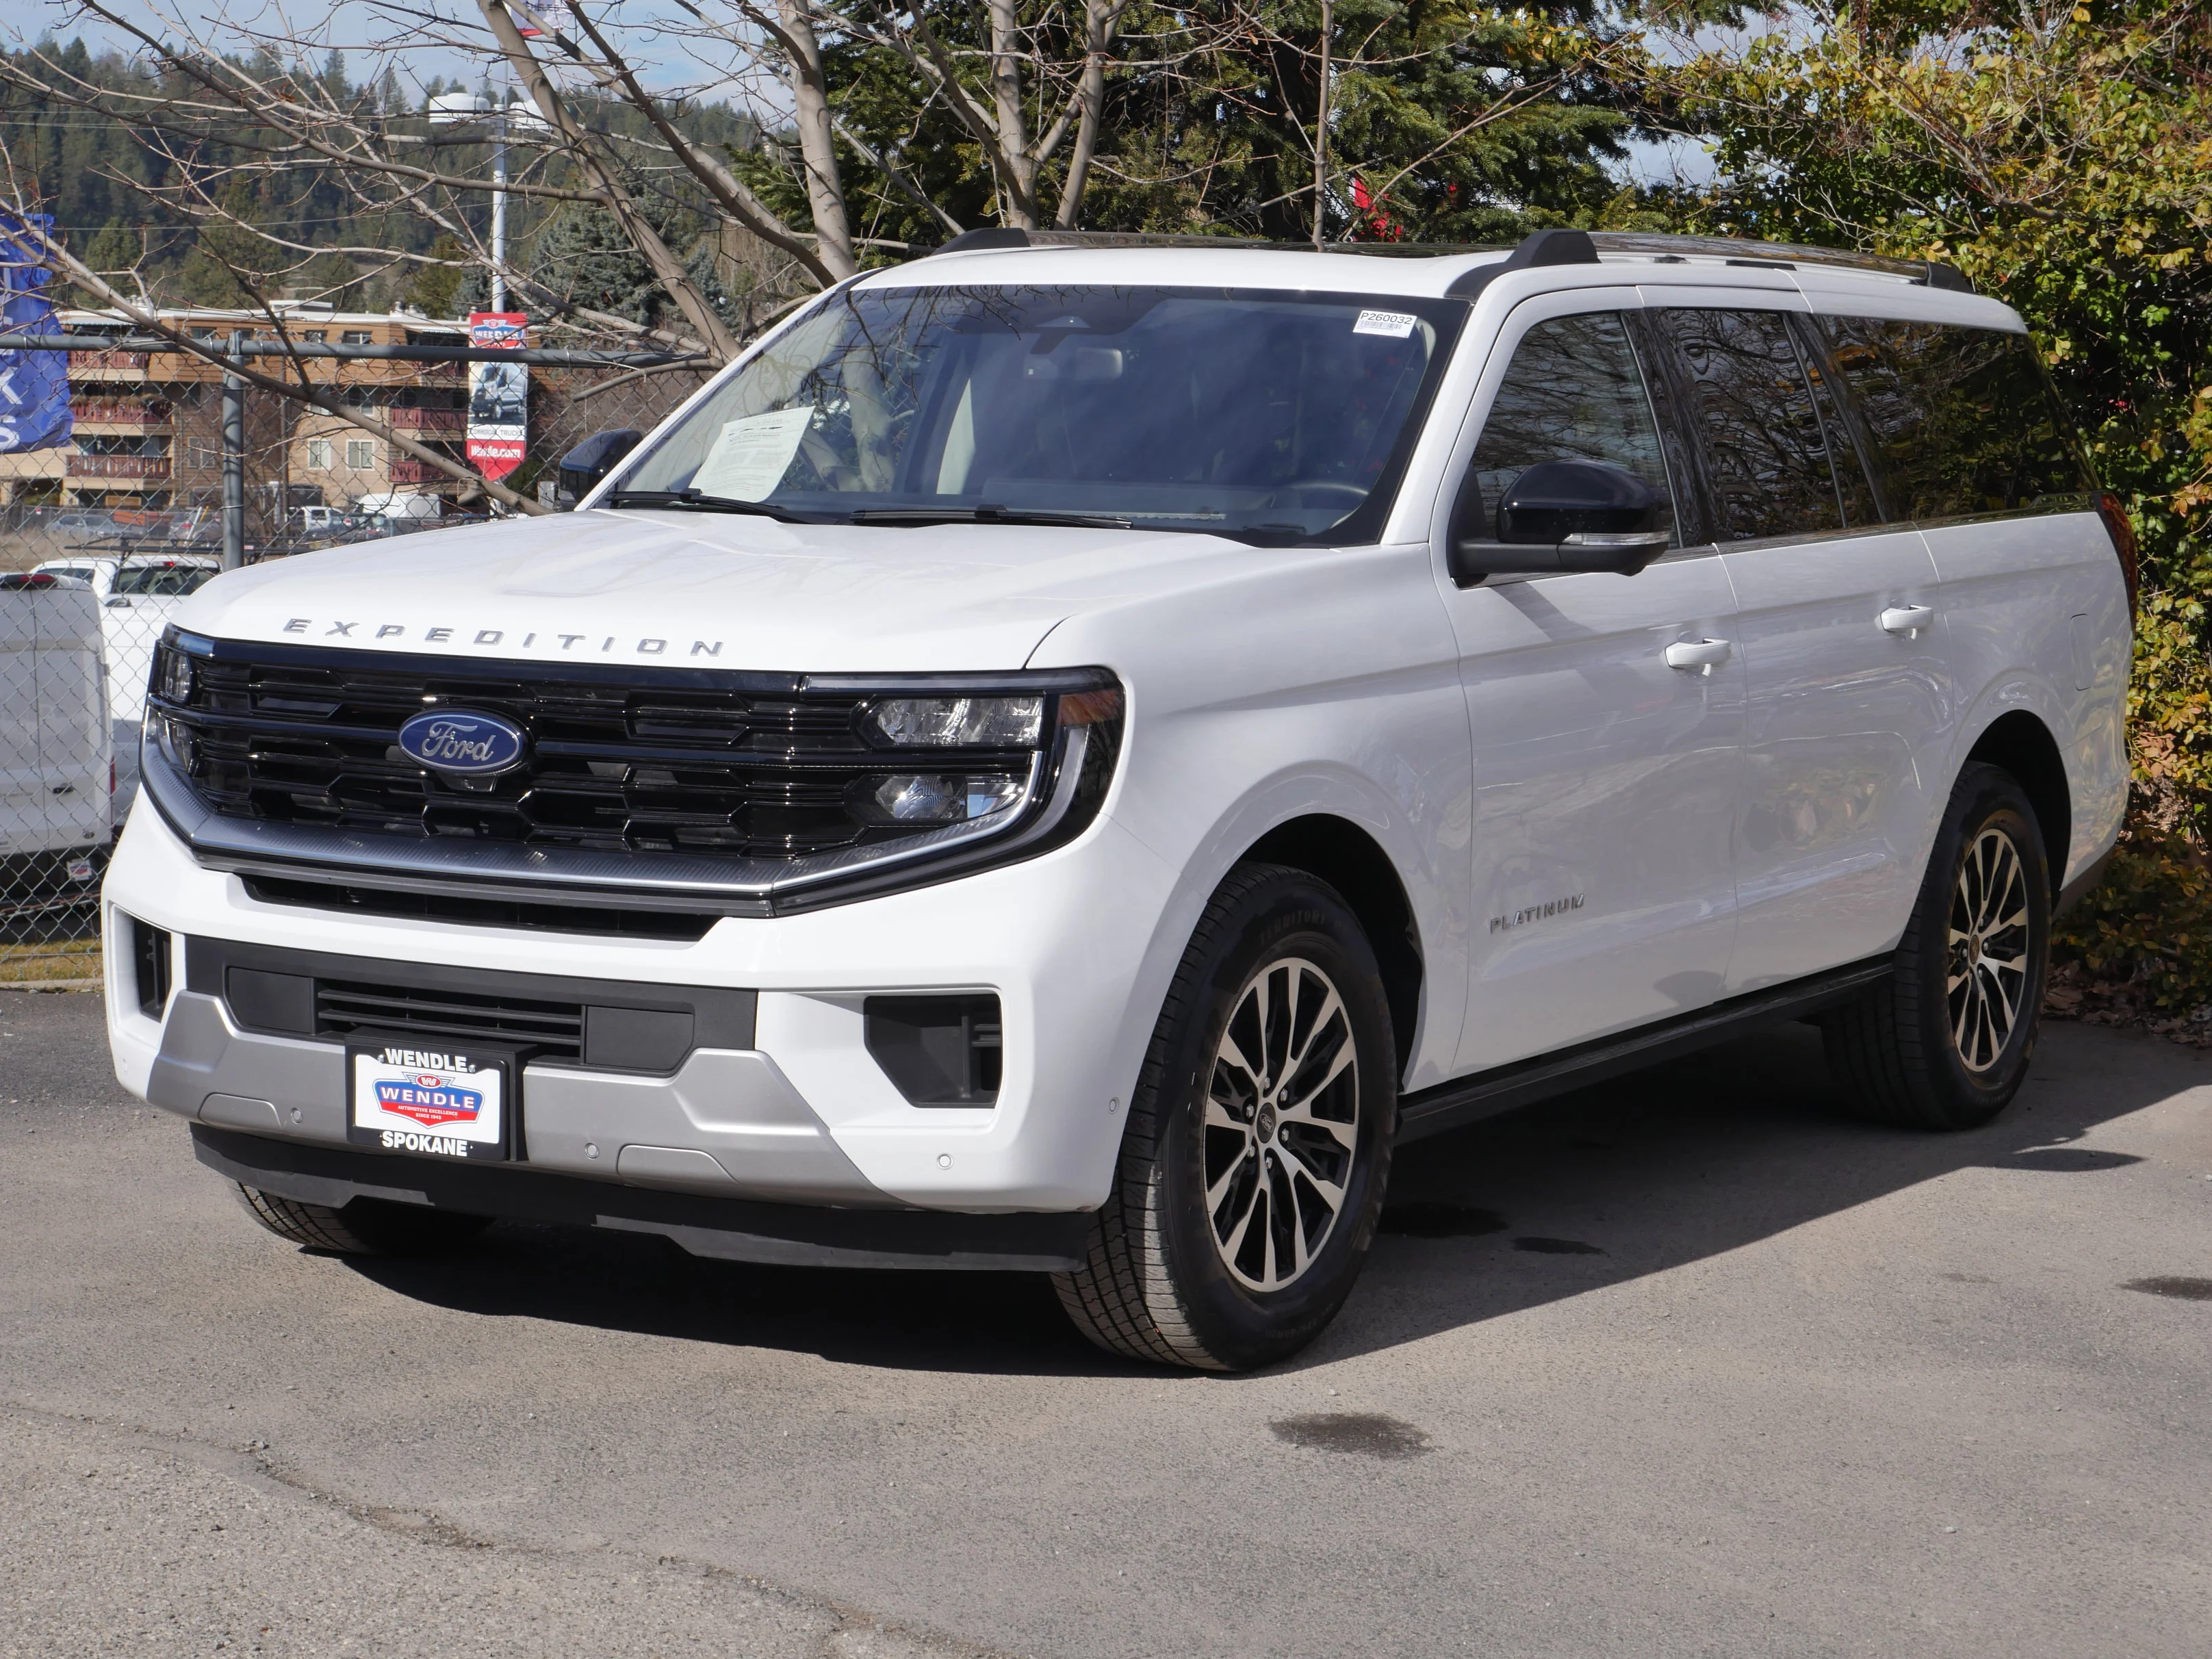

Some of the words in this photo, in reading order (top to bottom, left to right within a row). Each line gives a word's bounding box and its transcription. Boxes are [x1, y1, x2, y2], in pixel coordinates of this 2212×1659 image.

[1360, 312, 1413, 324] P260032
[282, 617, 724, 657] EXPEDITION
[422, 721, 496, 762] Ford
[1490, 893, 1584, 934] PLATINUM
[385, 1048, 467, 1072] WENDLE
[381, 1087, 474, 1109] WENDLE
[382, 1131, 467, 1157] SPOKANE
